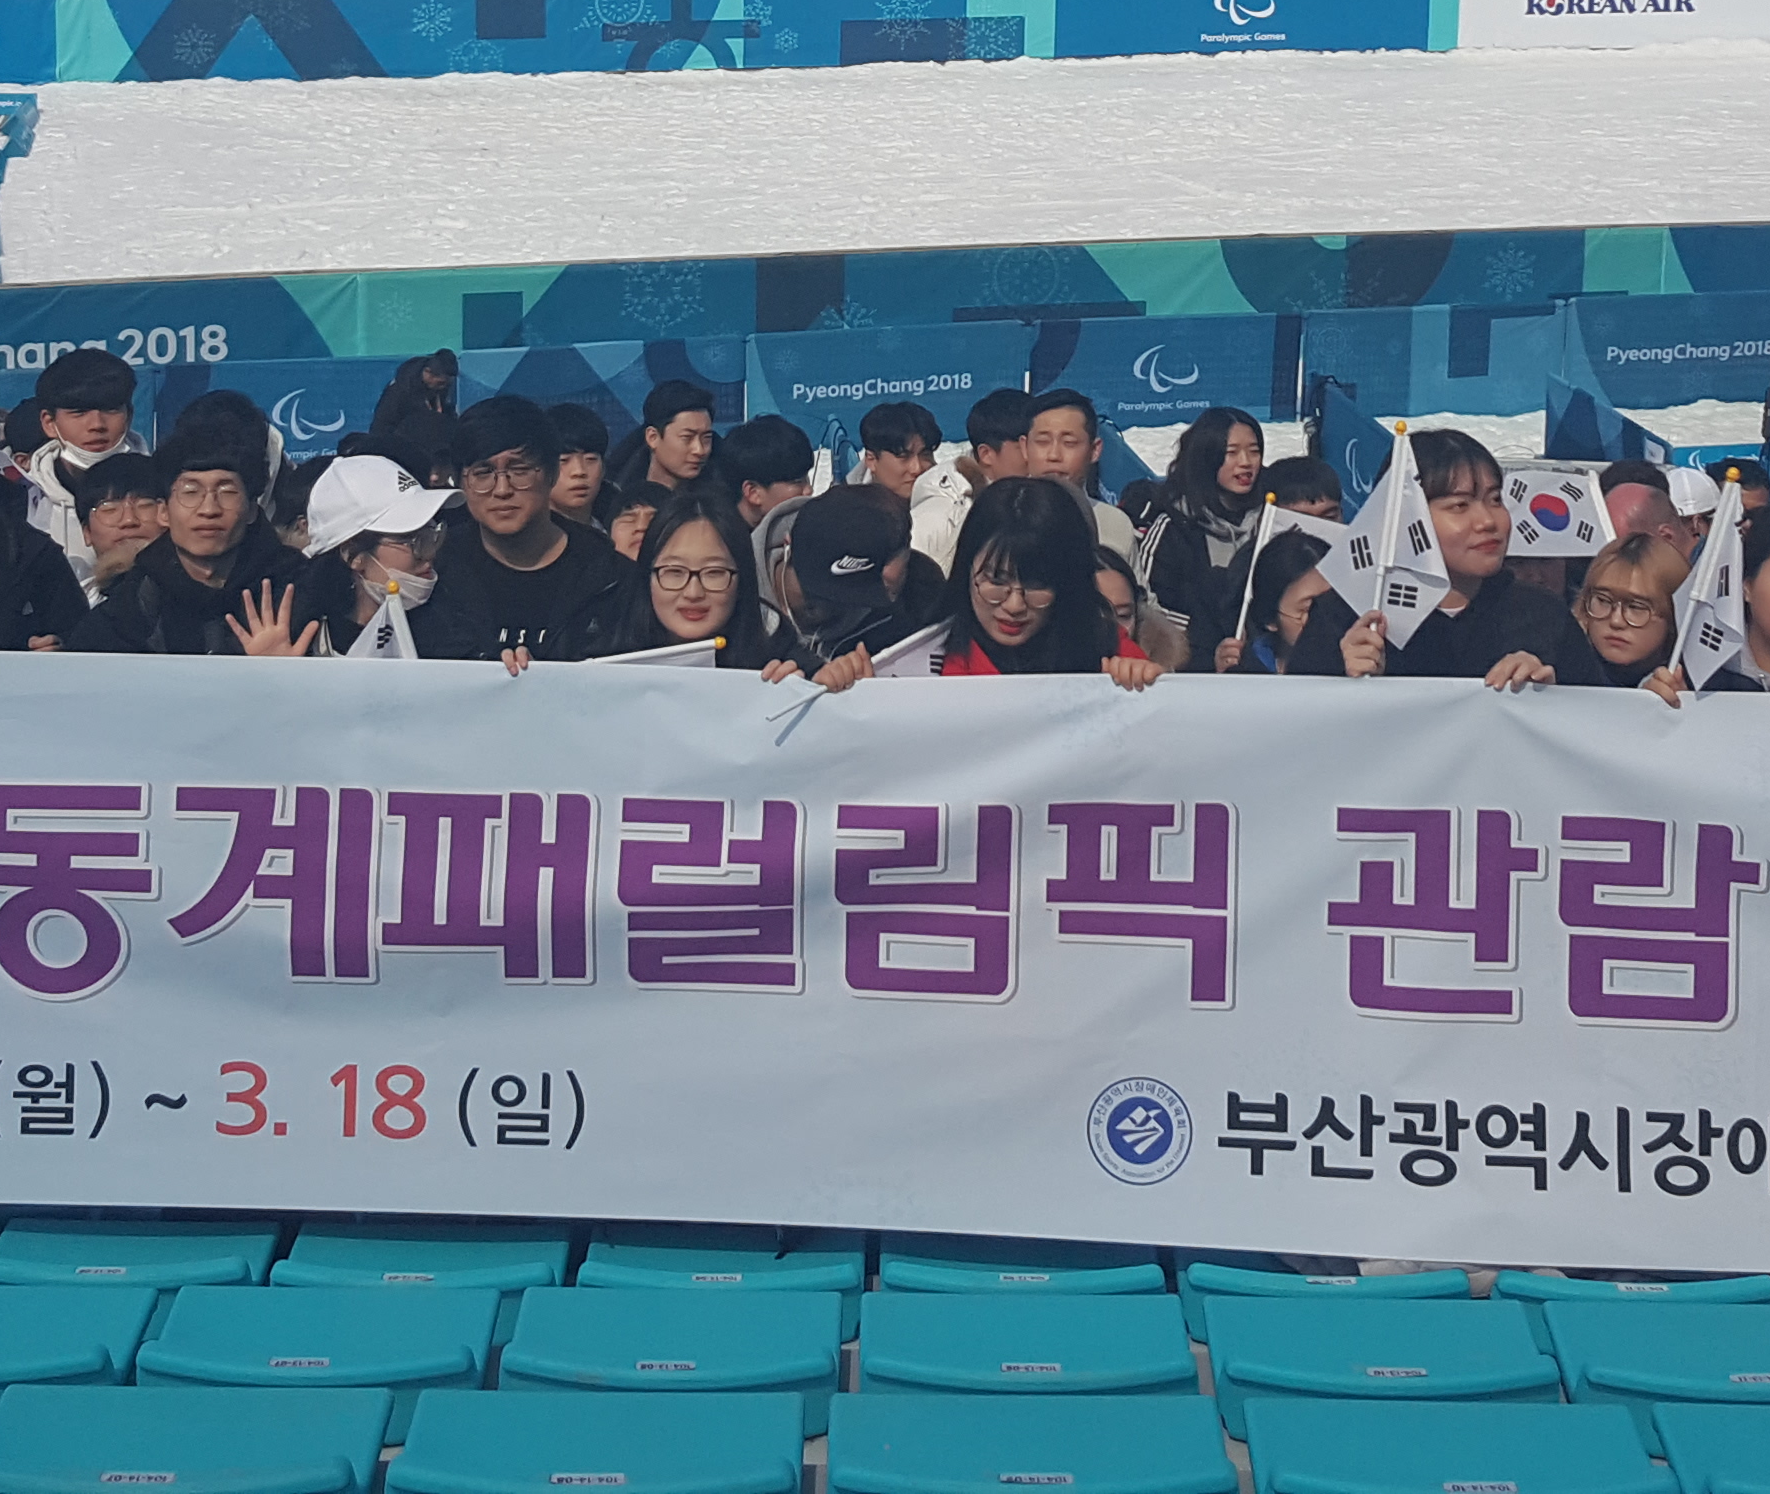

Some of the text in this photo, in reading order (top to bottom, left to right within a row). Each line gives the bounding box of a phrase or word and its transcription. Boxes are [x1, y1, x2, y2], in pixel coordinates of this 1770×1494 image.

[1200, 31, 1286, 44] Paralympic Games
[116, 324, 228, 365] 2018
[1606, 343, 1729, 365] PyeongChang
[792, 373, 972, 403] PyeongChang 2018
[1117, 399, 1210, 413] Paralympic Games
[1326, 804, 1766, 1028] 관람
[330, 1062, 429, 1141] 18
[456, 1067, 587, 1149] (일)
